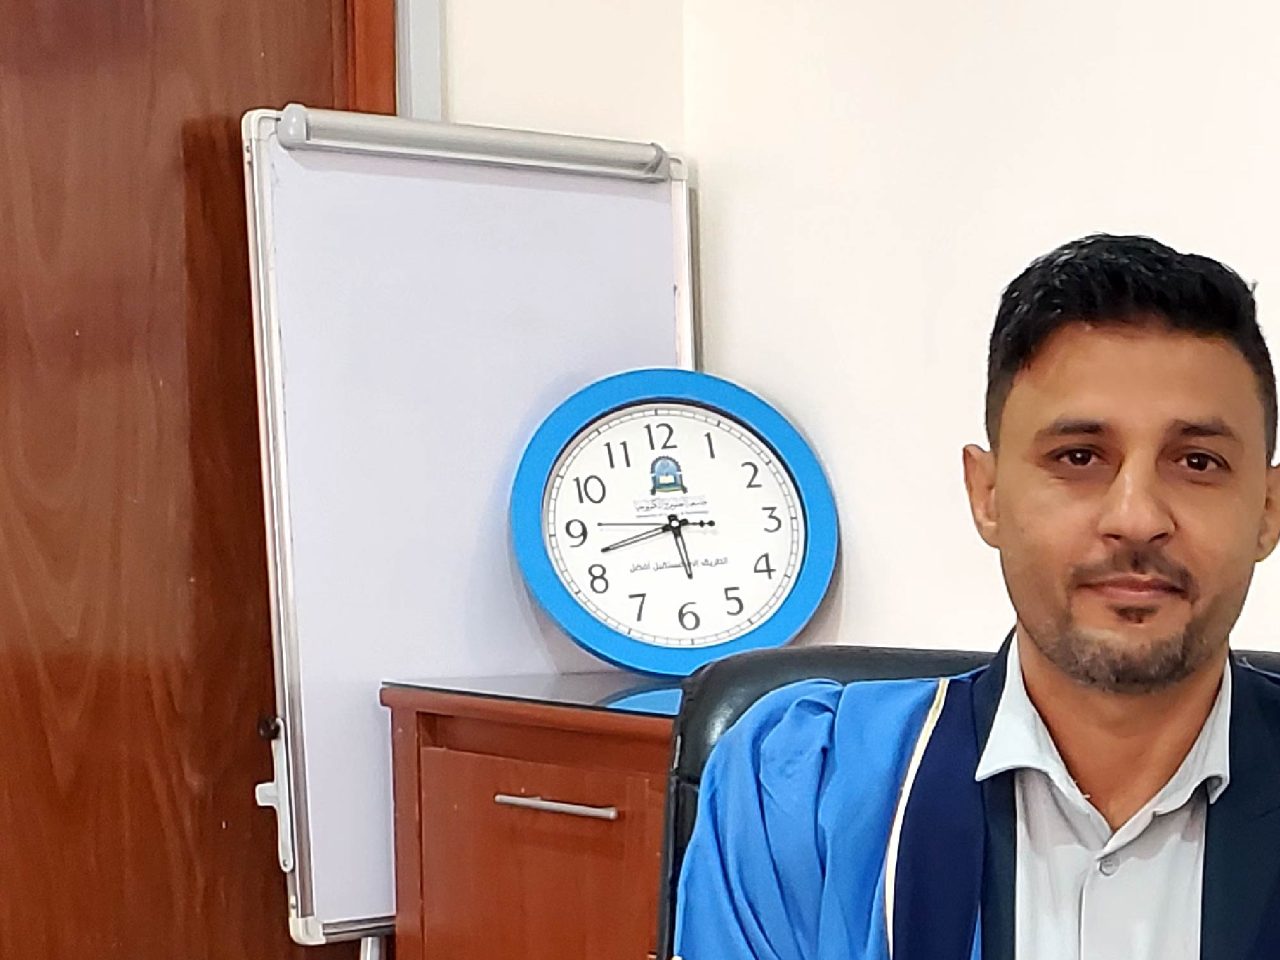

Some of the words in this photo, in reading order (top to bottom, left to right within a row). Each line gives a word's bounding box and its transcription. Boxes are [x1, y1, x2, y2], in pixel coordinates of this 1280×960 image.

[644, 423, 678, 450] 12
[704, 432, 716, 459] 1
[604, 441, 631, 468] 11
[741, 462, 762, 488] 2
[573, 475, 606, 503] 10
[565, 519, 588, 547] 9
[762, 507, 782, 533] 3
[588, 564, 609, 593] 8
[753, 553, 777, 580] 4
[629, 593, 647, 622] 7
[724, 587, 744, 616] 5
[678, 602, 700, 630] 6
